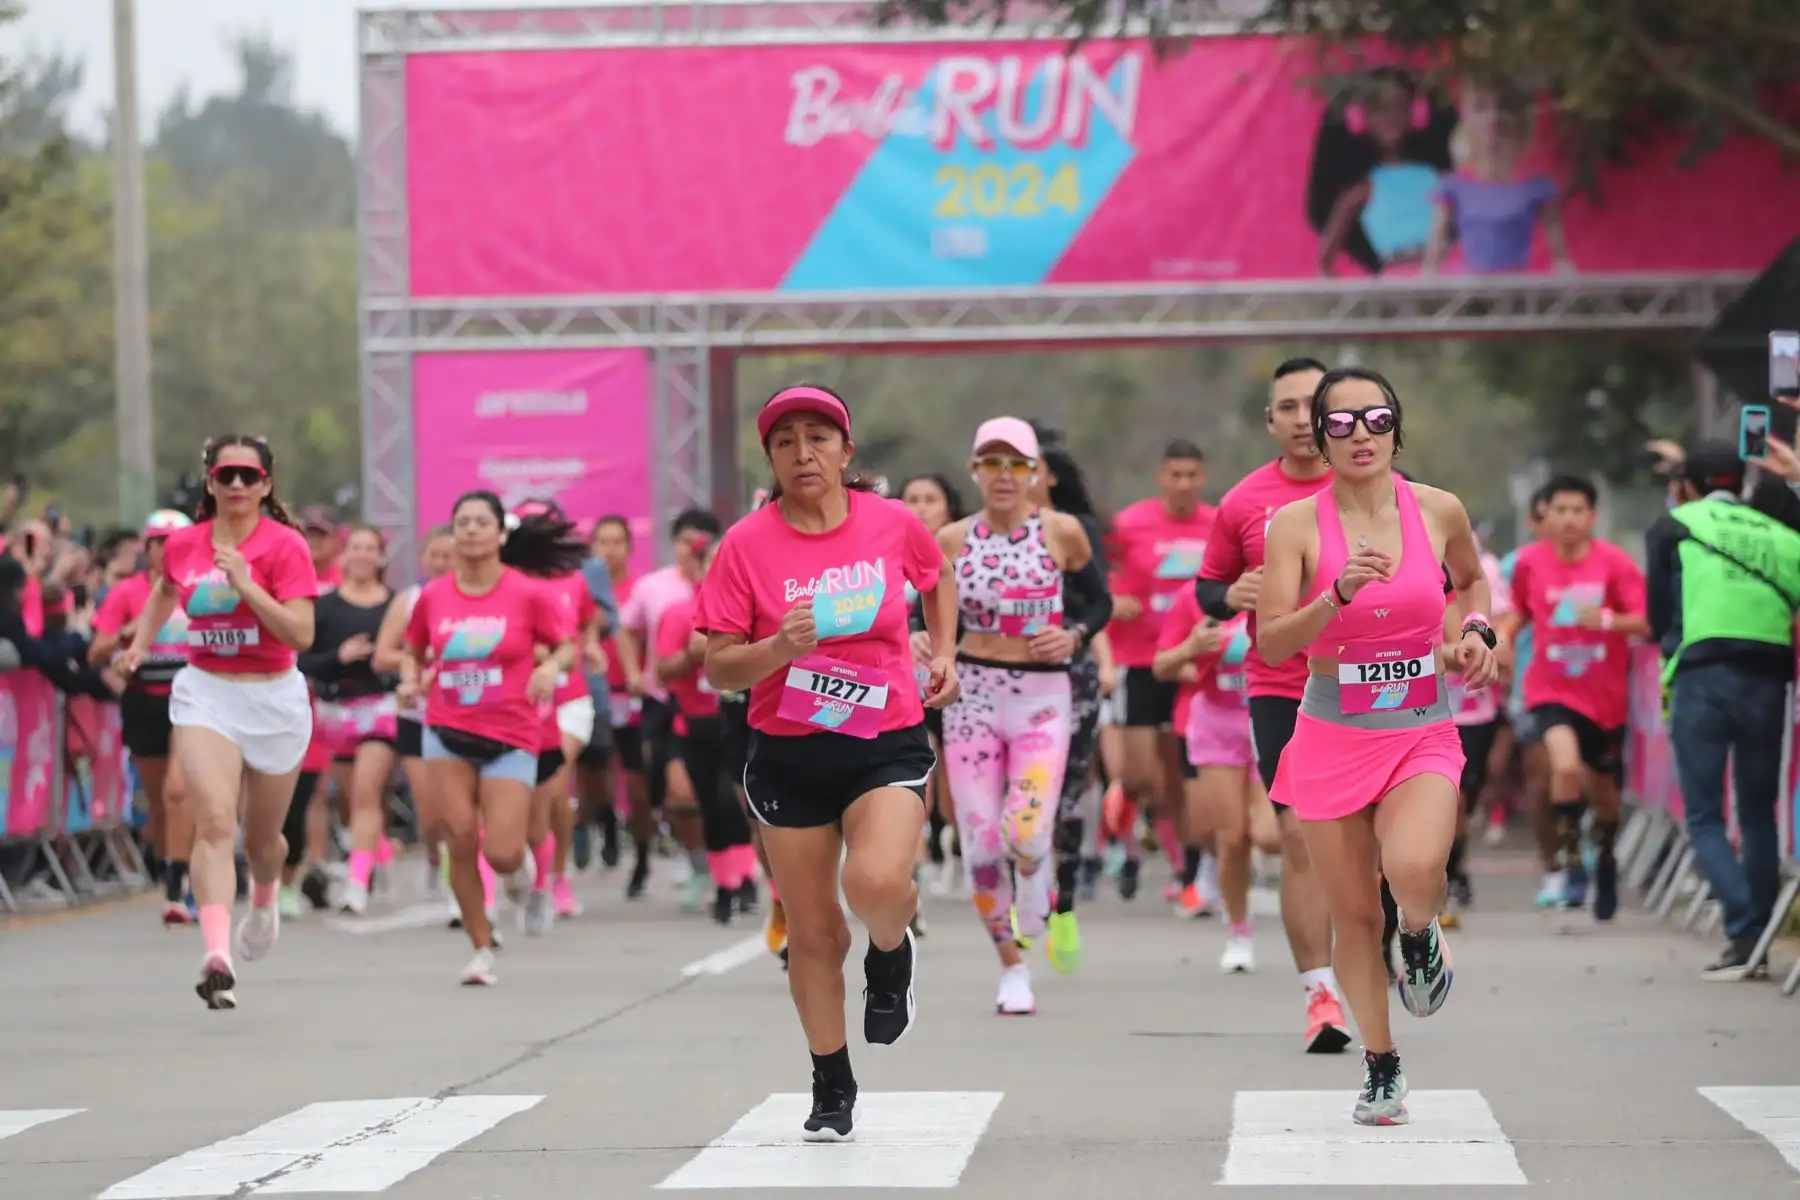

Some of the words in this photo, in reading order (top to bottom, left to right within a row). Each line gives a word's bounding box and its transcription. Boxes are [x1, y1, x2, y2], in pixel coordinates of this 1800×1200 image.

[786, 65, 932, 146] Barbie
[930, 50, 1143, 151] RUN
[934, 165, 1081, 217] 2024
[784, 576, 826, 602] Barbie
[825, 557, 885, 594] RUN
[833, 594, 877, 615] 2024
[1376, 650, 1401, 658] aruma
[831, 665, 858, 677] aruma
[1358, 659, 1422, 682] 12190
[810, 673, 871, 704] 11277
[1386, 681, 1409, 695] RUN
[831, 700, 855, 714] RUN
